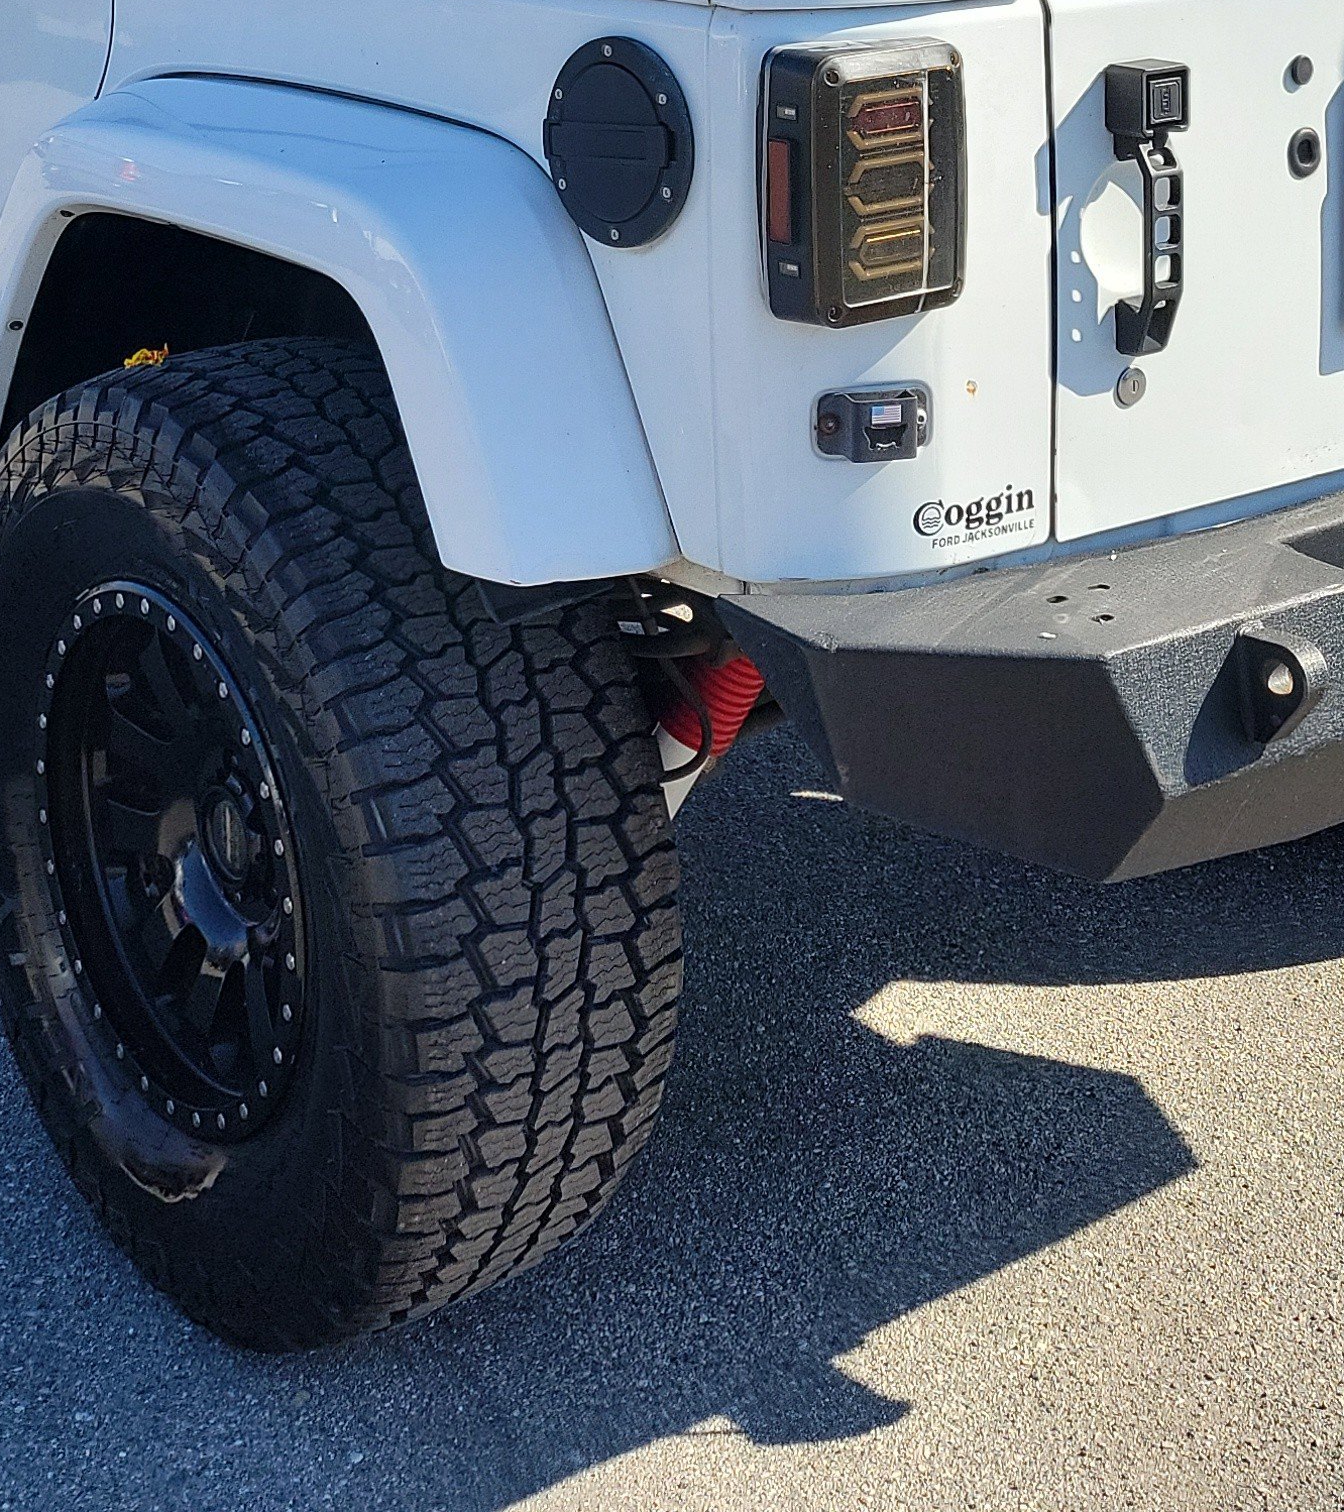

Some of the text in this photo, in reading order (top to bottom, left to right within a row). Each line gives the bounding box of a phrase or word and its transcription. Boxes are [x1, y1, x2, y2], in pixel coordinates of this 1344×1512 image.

[913, 484, 1034, 536] Coggin
[932, 519, 1034, 548] FORD JACKSONVILLE
